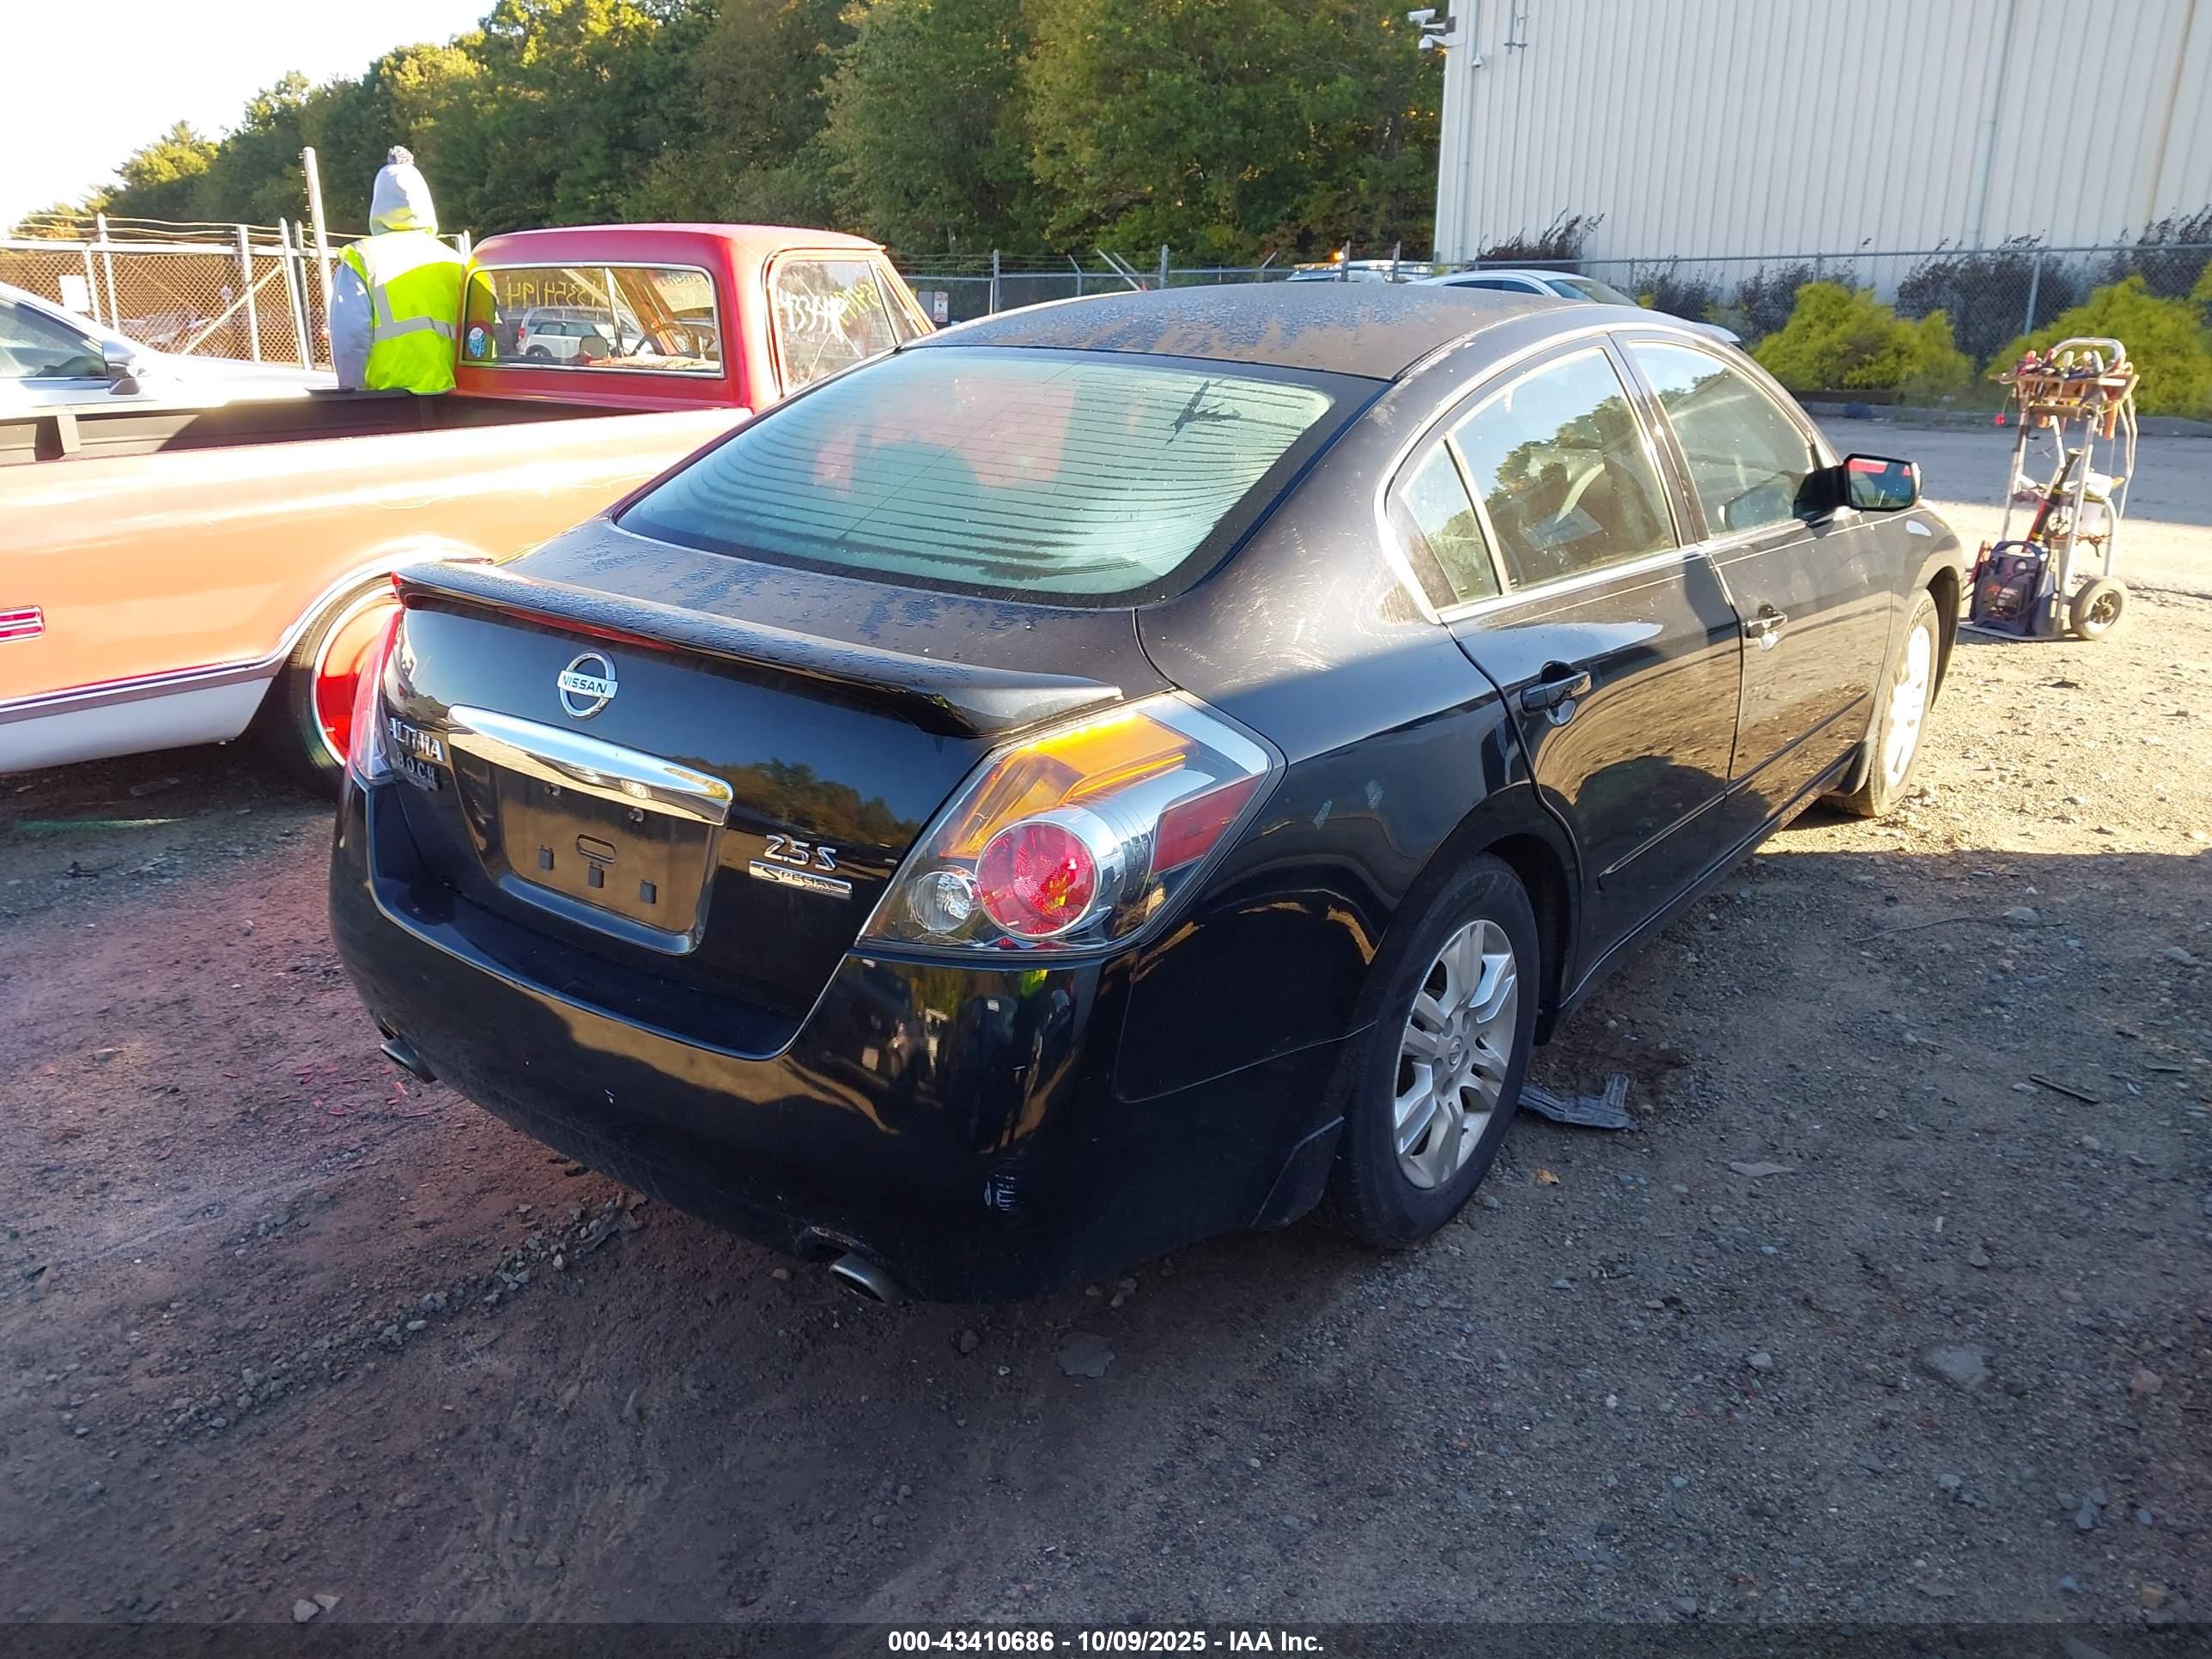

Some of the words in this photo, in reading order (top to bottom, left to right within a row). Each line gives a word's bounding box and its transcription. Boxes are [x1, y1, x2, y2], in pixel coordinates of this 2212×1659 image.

[562, 675, 607, 694] NISSAN
[388, 717, 445, 763] ALTIMA
[815, 847, 837, 872] S
